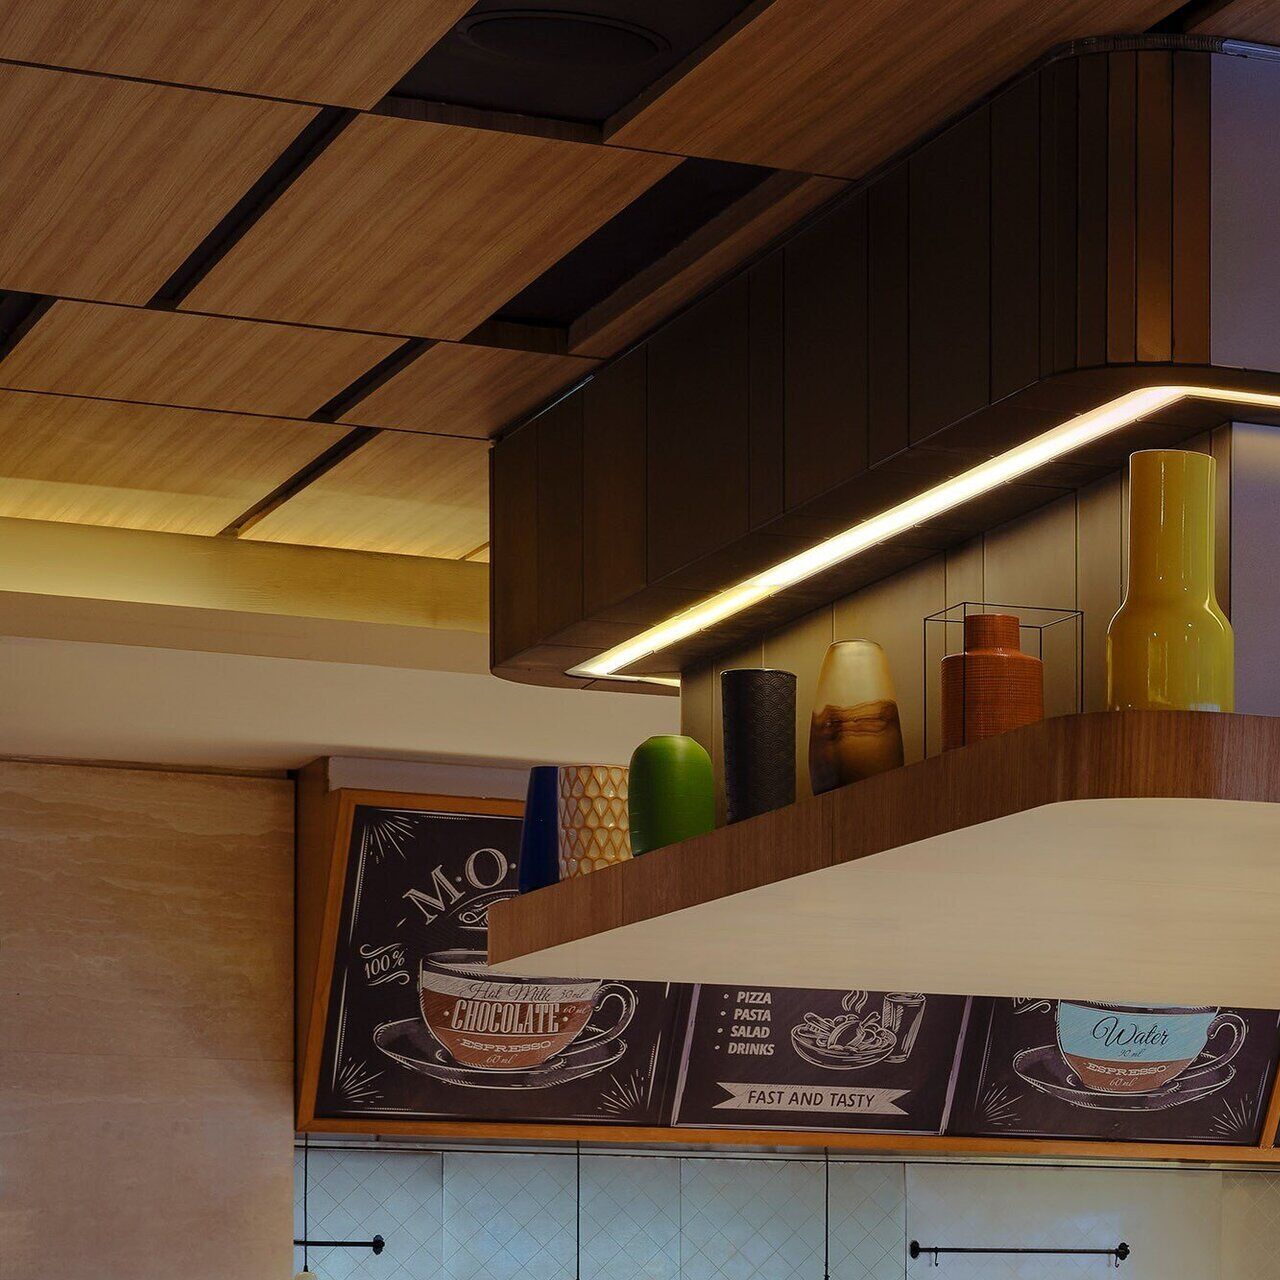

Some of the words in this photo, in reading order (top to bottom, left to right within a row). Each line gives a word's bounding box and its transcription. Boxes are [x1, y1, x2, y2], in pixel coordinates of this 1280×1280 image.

[364, 949, 405, 979] 100%
[465, 982, 501, 1000] Hot
[507, 984, 551, 1001] Milk
[736, 991, 772, 1005] PIZZA
[451, 999, 560, 1034] CHOCOLATE
[733, 1008, 772, 1022] PASTA
[730, 1025, 771, 1039] SALAD
[1091, 1016, 1169, 1047] Water
[460, 1039, 552, 1053] ESPRESSO
[727, 1042, 775, 1056] DRINKS
[1085, 1062, 1168, 1077] ESPRESSO
[748, 1090, 784, 1105] FAST
[788, 1091, 824, 1106] AND
[830, 1093, 875, 1108] TASTY
